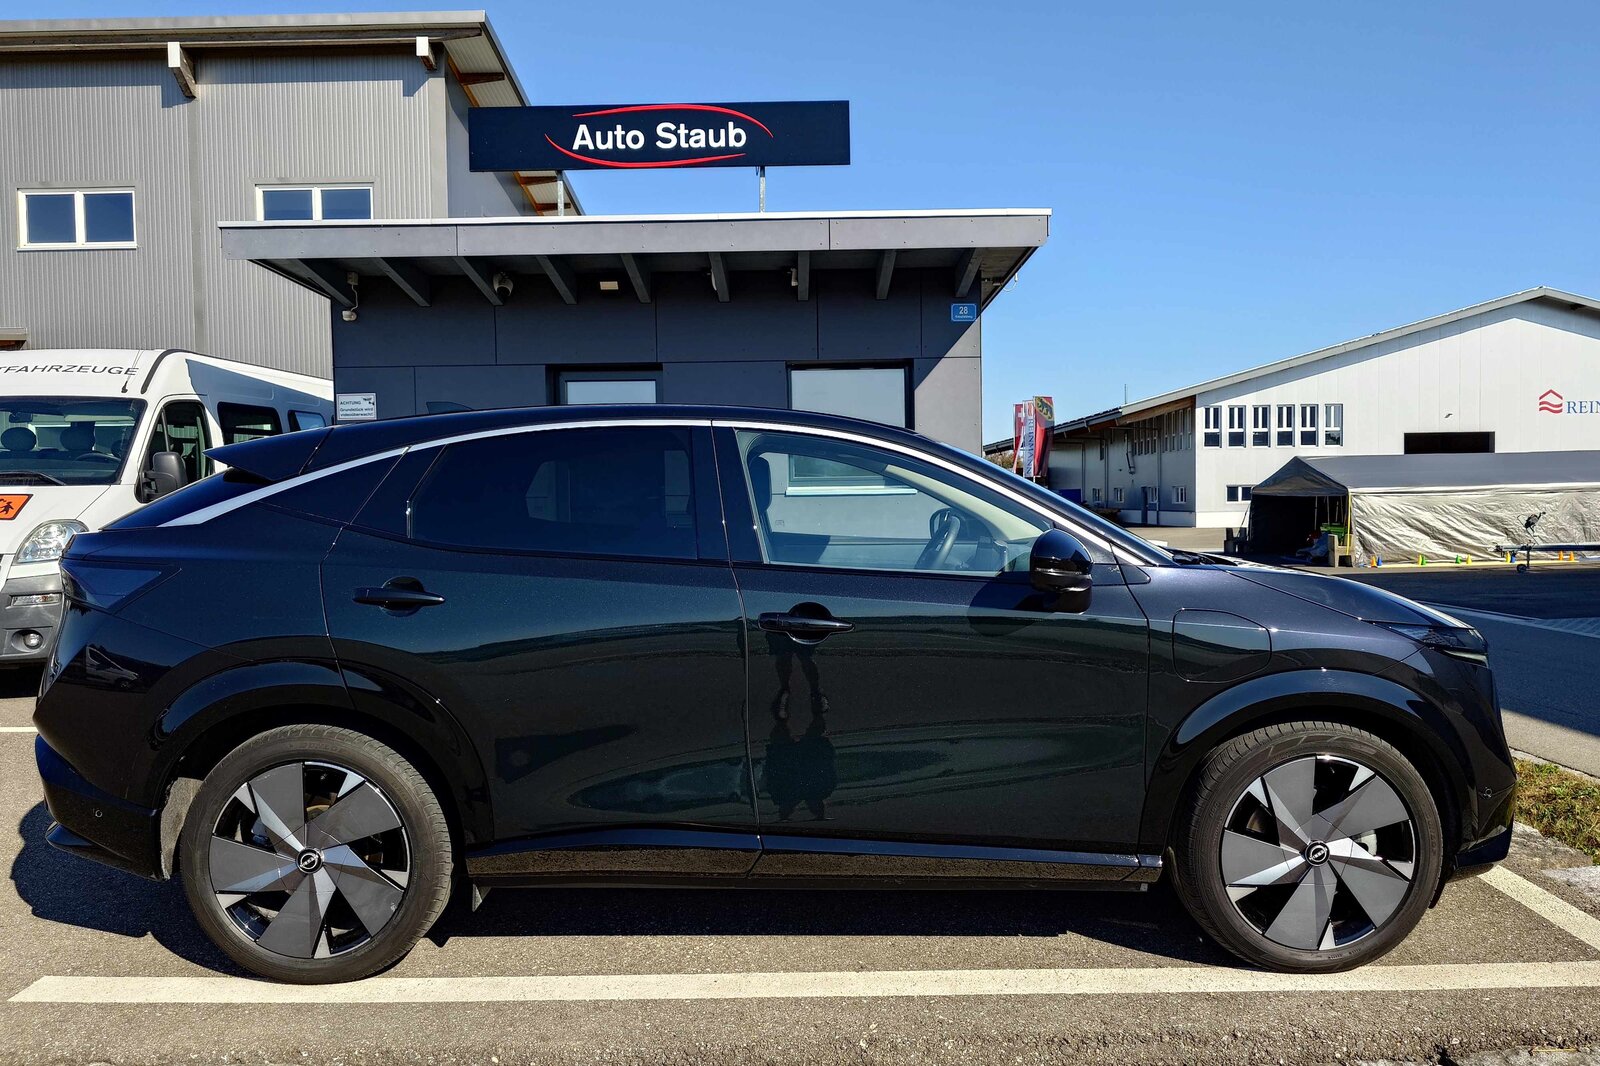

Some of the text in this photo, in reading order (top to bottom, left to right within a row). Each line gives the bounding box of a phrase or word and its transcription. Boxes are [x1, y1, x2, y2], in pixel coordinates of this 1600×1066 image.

[572, 121, 747, 150] Auto Staub
[959, 306, 968, 314] 28
